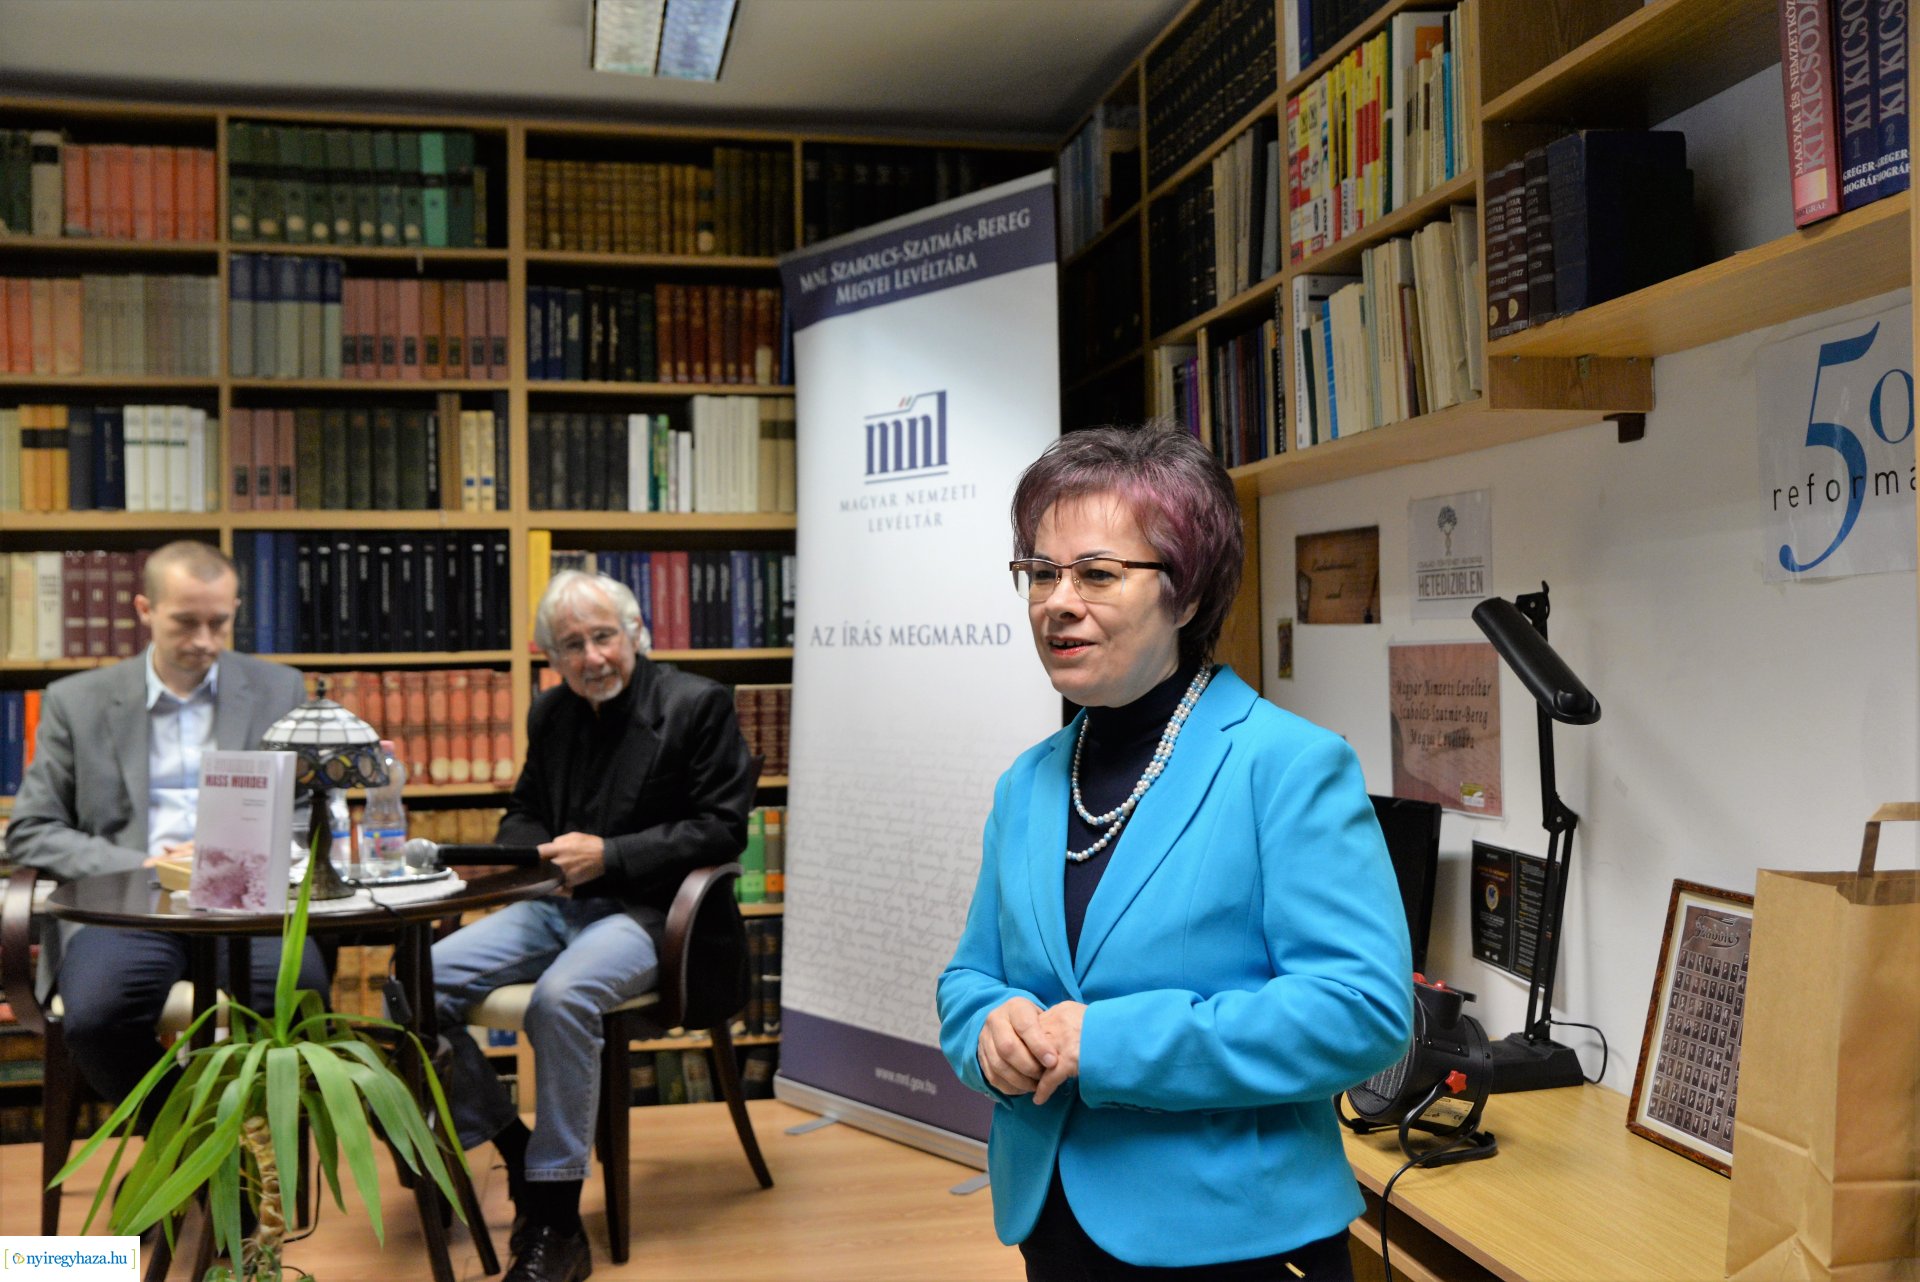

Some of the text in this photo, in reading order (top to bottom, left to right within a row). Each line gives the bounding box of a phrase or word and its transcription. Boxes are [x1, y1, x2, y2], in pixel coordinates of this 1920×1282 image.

[1790, 92, 1800, 110] ÉS
[1798, 0, 1825, 170] KI KICSOD
[1879, 79, 1905, 123] KI
[1843, 94, 1871, 137] KI
[1792, 111, 1804, 175] MAGYAR
[835, 251, 978, 305] MEGYEI LEVÉLTÁRA
[839, 484, 977, 513] MAGYAR NEMZETI
[868, 510, 943, 533] LEVÉLTÁR
[810, 620, 1011, 647] AZ ÍRÁS MEGMARAD
[205, 774, 268, 789] MASS MURDER
